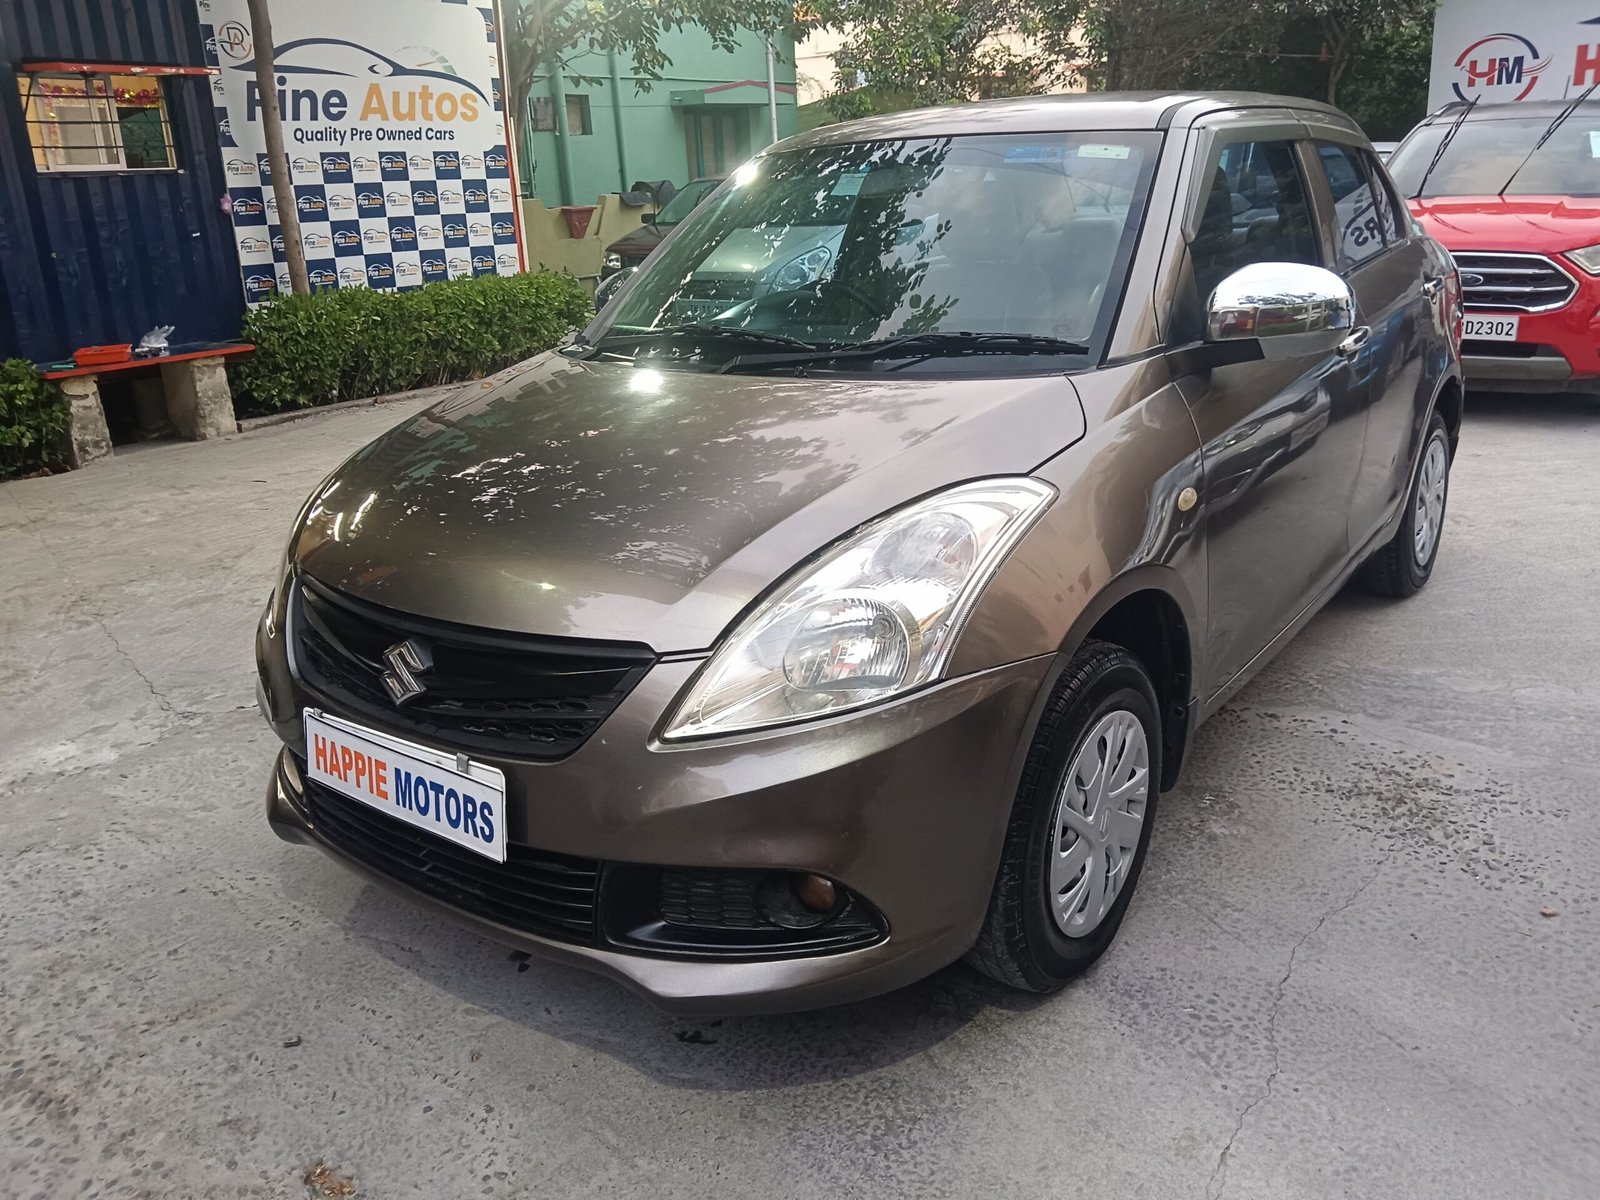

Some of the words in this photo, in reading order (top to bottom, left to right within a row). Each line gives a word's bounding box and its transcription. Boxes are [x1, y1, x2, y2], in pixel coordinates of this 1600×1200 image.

[1467, 56, 1524, 88] HM
[360, 83, 479, 122] Autos
[293, 126, 347, 146] Quality
[351, 127, 373, 141] Pre
[376, 126, 422, 141] Owned
[425, 127, 455, 141] Cars
[1461, 320, 1515, 337] D2302
[314, 733, 389, 801] HAPPIE
[394, 767, 495, 844] MOTORS
